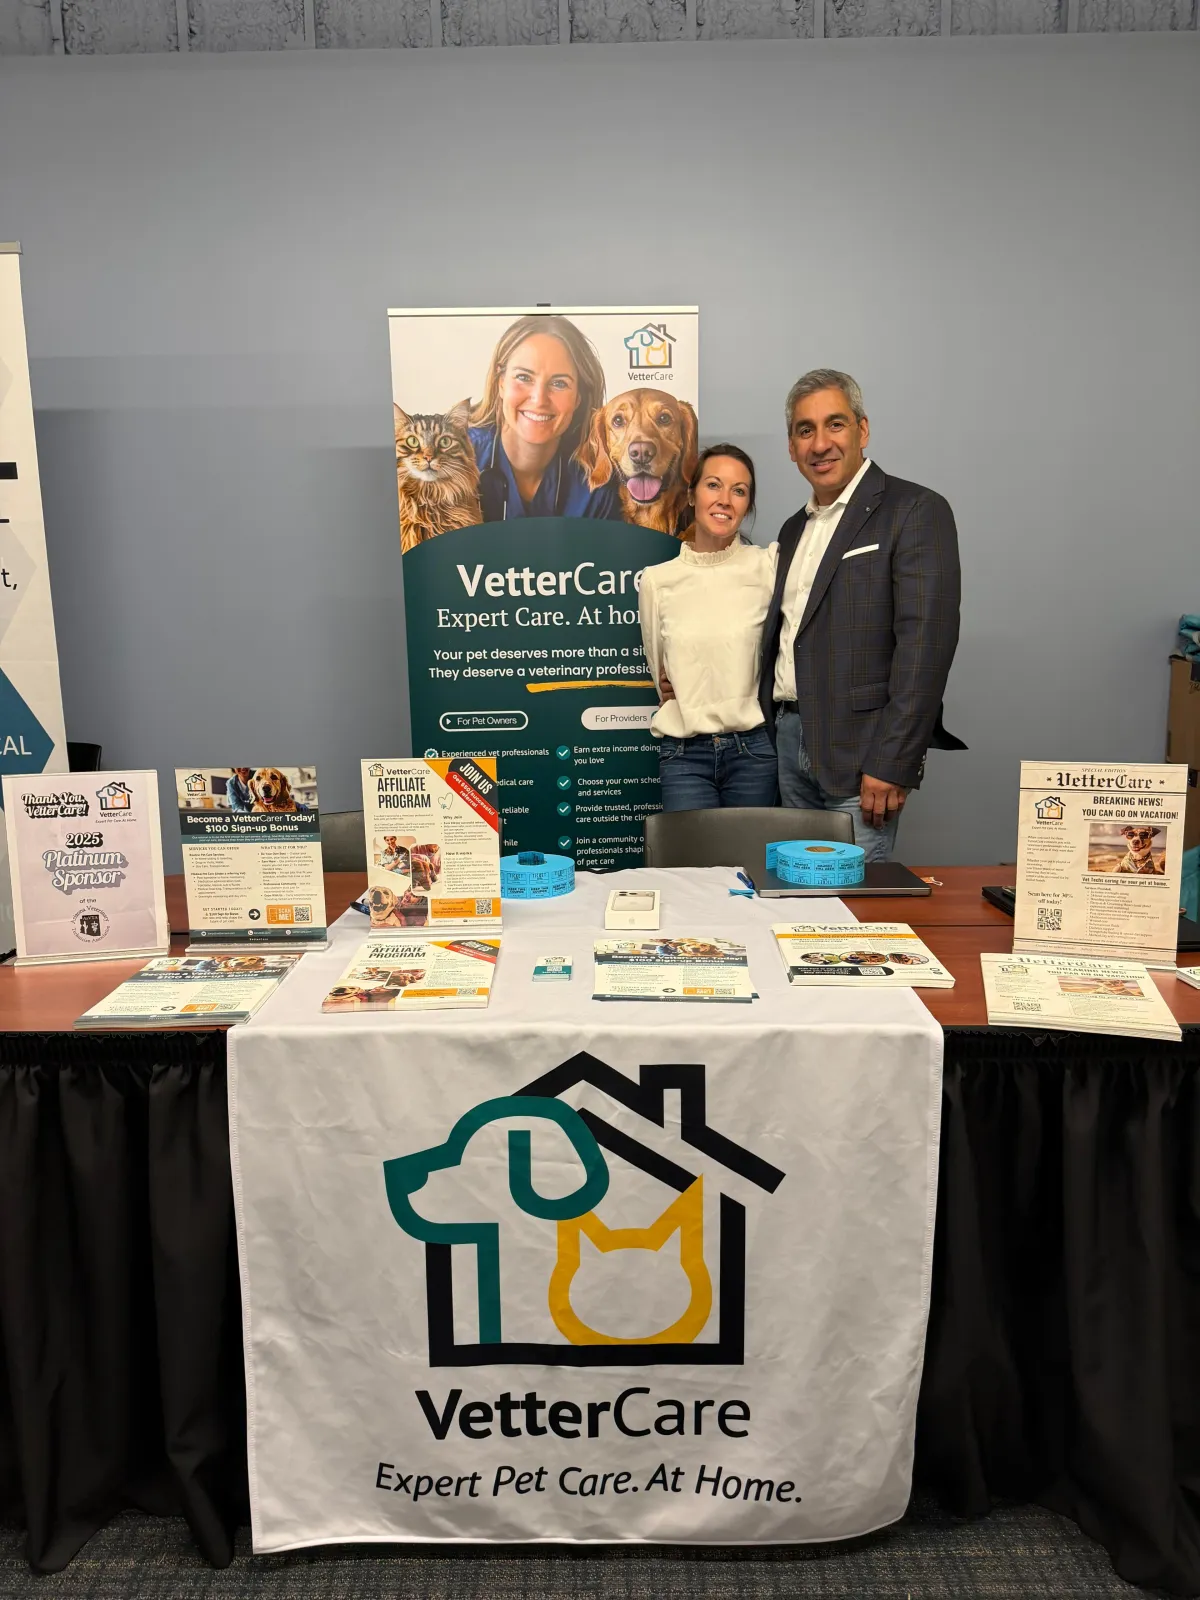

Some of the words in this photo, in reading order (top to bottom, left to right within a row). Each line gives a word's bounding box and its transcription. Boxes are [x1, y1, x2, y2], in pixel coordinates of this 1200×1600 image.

[627, 372, 674, 381] VetterCare
[436, 608, 509, 632] Expert
[515, 607, 571, 627] Care.
[576, 606, 602, 626] At
[433, 649, 464, 661] Your
[466, 649, 488, 662] pet
[490, 647, 549, 660] deserves
[551, 648, 585, 658] more
[587, 646, 618, 657] than
[620, 649, 629, 657] a
[428, 667, 459, 681] They
[462, 666, 514, 677] deserve
[516, 668, 526, 677] a
[528, 664, 593, 678] veterinary
[457, 717, 470, 726] For
[472, 717, 485, 726] Pet
[486, 716, 518, 726] Owners
[595, 714, 608, 723] For
[609, 713, 648, 723] Providers
[441, 749, 488, 758] Experienced
[488, 749, 500, 757] vet
[501, 748, 550, 758] professionals
[573, 745, 590, 754] Earn
[591, 745, 611, 753] extra
[612, 744, 637, 753] income
[638, 743, 661, 754] doing
[573, 757, 587, 766] you
[588, 756, 605, 765] love
[377, 777, 426, 792] AFFILIATE
[452, 774, 462, 784] Get
[459, 763, 483, 785] JOIN
[477, 779, 493, 795] US
[577, 778, 601, 786] Choose
[602, 778, 622, 787] your
[623, 777, 640, 785] own
[1056, 772, 1153, 790] VetterCare
[577, 788, 589, 797] and
[591, 788, 622, 796] services
[21, 792, 60, 806] Thank
[59, 791, 87, 805] You,
[378, 794, 431, 809] PROGRAM
[1093, 796, 1136, 806] BREAKING
[1137, 797, 1164, 807] NEWS!
[24, 803, 90, 819] VetterCare!
[501, 806, 530, 814] reliable
[575, 804, 602, 813] Provide
[604, 803, 632, 813] trusted,
[187, 816, 224, 824] Become
[232, 814, 284, 823] VetterCarer
[285, 813, 316, 823] Today!
[592, 814, 618, 823] outside
[620, 814, 632, 823] the
[1081, 808, 1098, 817] YOU
[1098, 809, 1114, 818] CAN
[1115, 810, 1126, 818] GO
[1127, 810, 1138, 818] ON
[1139, 810, 1179, 820] VACATION!
[205, 824, 229, 833] $100
[231, 824, 268, 834] Sign-up
[269, 823, 299, 832] Bonus
[66, 831, 103, 848] 2025
[575, 836, 589, 845] Join
[597, 835, 637, 845] community
[576, 845, 624, 855] professionals
[625, 844, 645, 854] shapi
[42, 850, 128, 873] Platinum
[576, 857, 585, 866] of
[586, 857, 599, 867] pet
[52, 869, 125, 895] Sponsor
[414, 1387, 752, 1440] VetterCare
[375, 1462, 482, 1502] Expert
[492, 1465, 548, 1497] Pet
[558, 1465, 640, 1497] Care.
[644, 1463, 685, 1493] At
[694, 1464, 803, 1504] Home.
